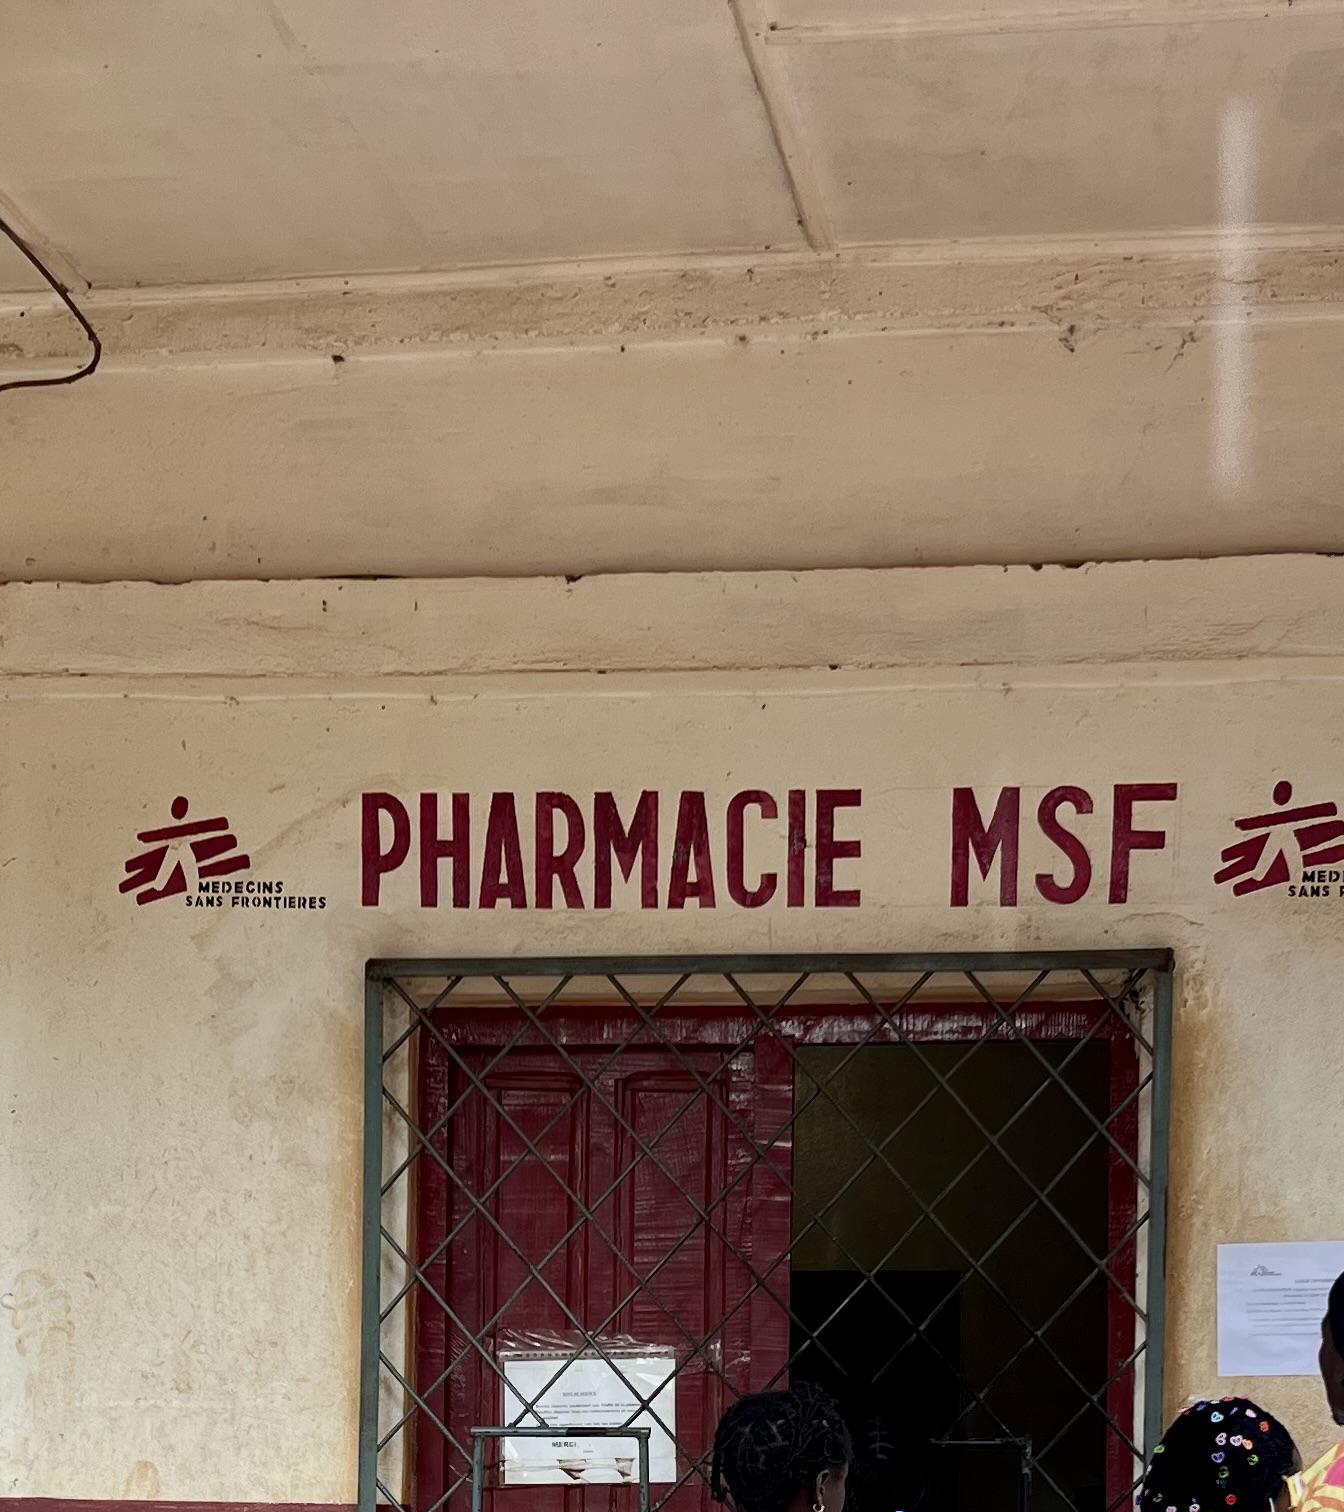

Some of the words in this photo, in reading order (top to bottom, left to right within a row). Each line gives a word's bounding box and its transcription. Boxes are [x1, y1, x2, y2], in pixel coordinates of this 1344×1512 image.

[363, 790, 861, 909] PHARMACIE
[952, 784, 1178, 907] MSF
[198, 880, 284, 894] MEDECINS
[1287, 885, 1330, 898] SANS
[185, 895, 223, 908] SANS
[231, 896, 327, 909] FRONTIERES
